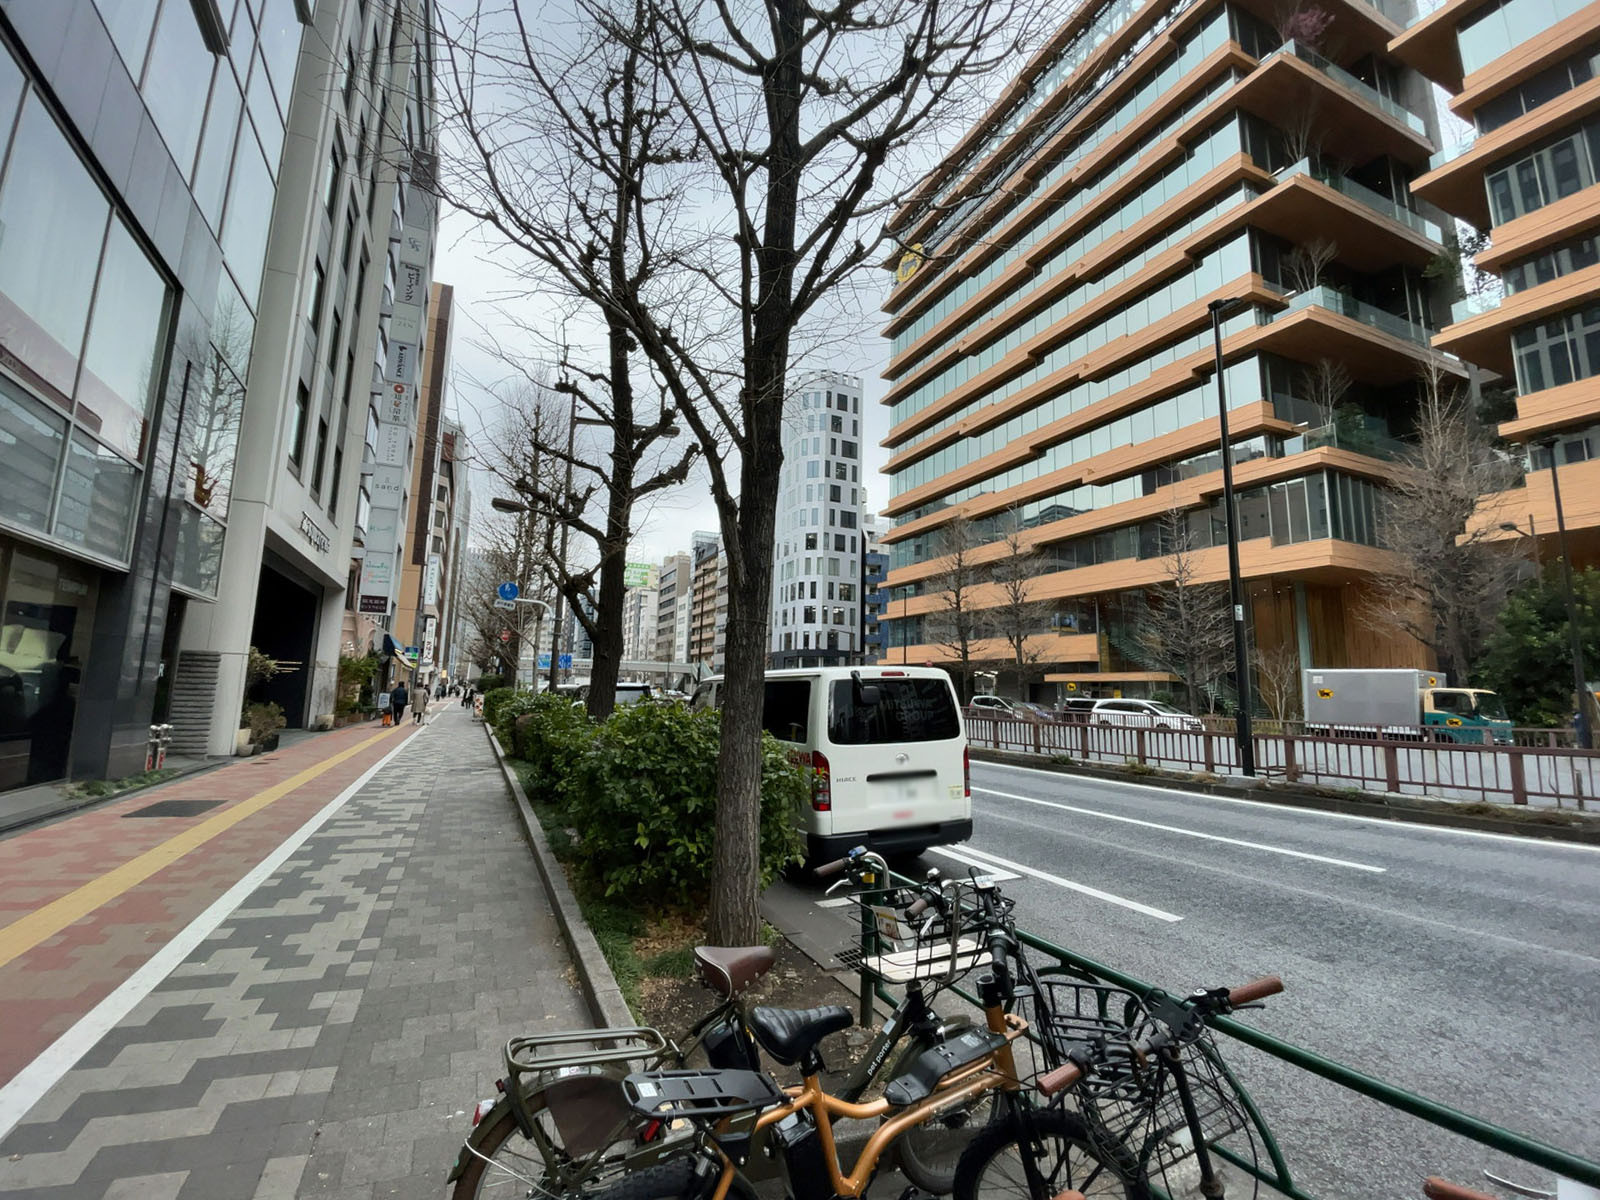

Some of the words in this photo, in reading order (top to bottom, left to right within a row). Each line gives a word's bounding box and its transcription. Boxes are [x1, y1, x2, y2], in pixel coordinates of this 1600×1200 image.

[896, 711, 934, 721] GROUP
[867, 1061, 877, 1076] pet
[875, 1039, 892, 1063] porter
